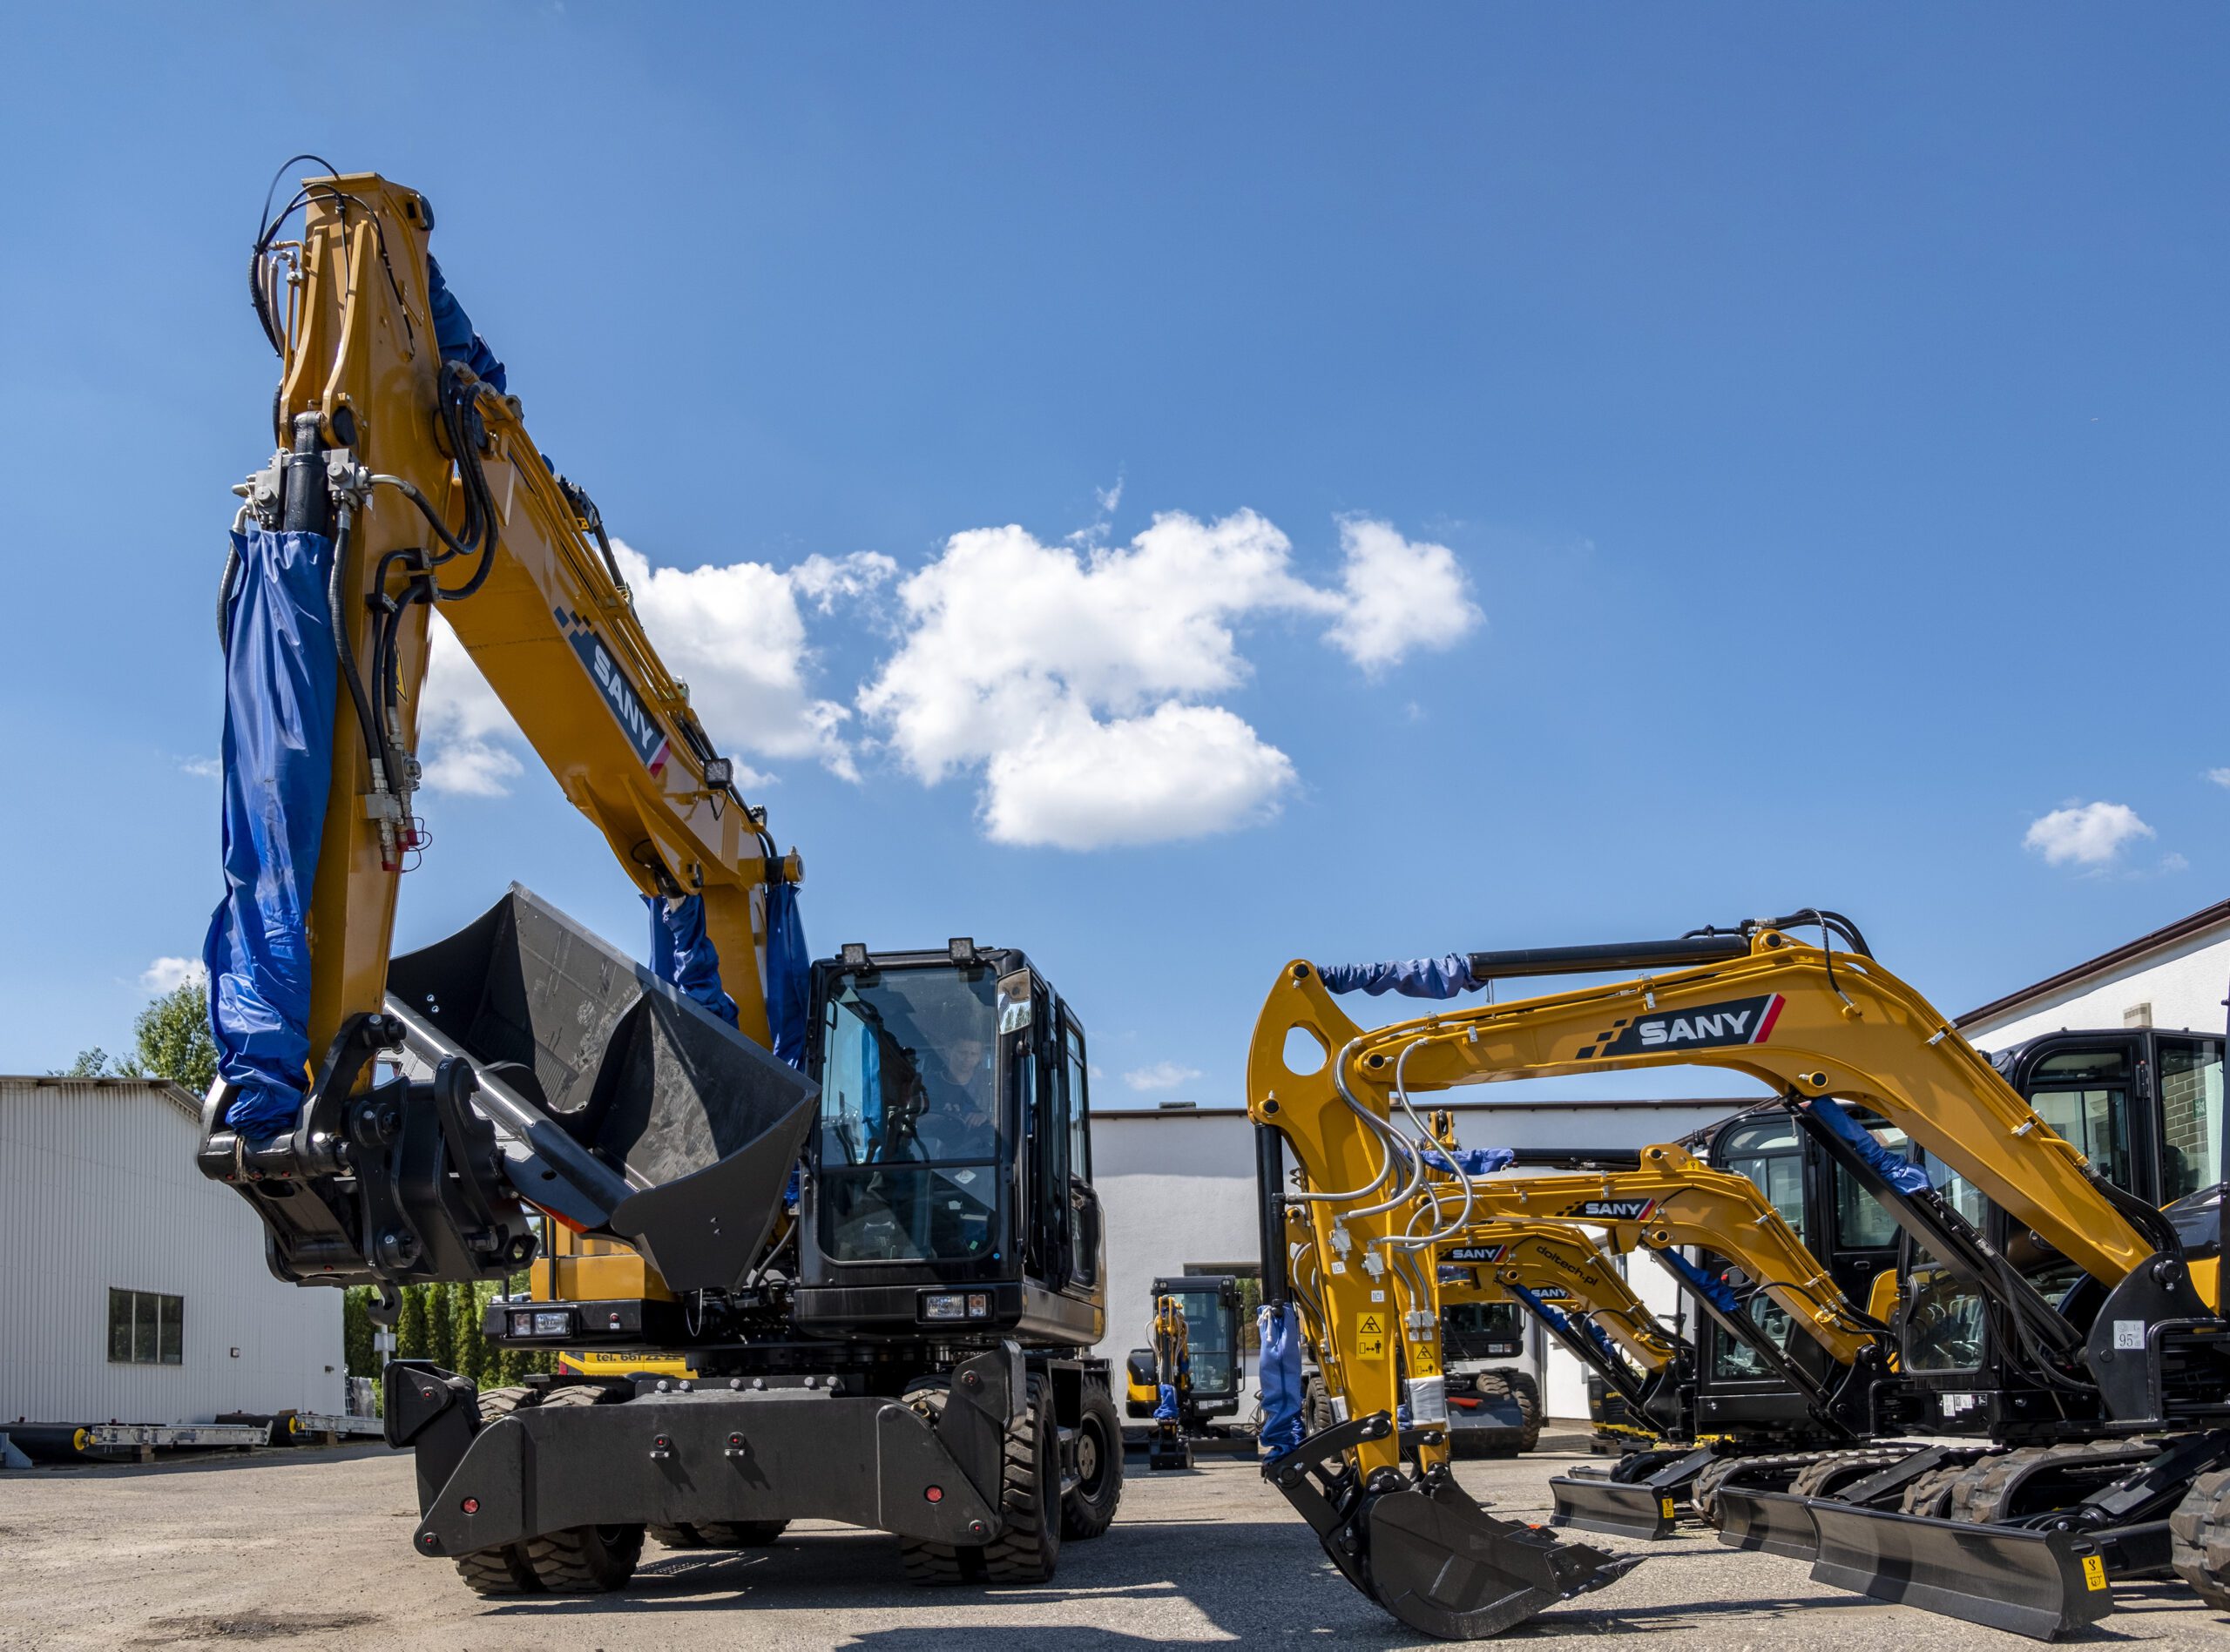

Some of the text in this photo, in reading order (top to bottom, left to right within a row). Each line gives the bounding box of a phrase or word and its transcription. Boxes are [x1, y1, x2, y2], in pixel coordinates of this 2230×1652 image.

[594, 644, 653, 750] SANY
[1639, 1010, 1751, 1045] SANY
[1585, 1203, 1641, 1215] SANY
[1452, 1249, 1496, 1258] SANY
[1537, 1245, 1598, 1286] doltech.pl
[1531, 1289, 1566, 1298] SANY
[2119, 1333, 2133, 1347] 95
[596, 1352, 617, 1362] tel.
